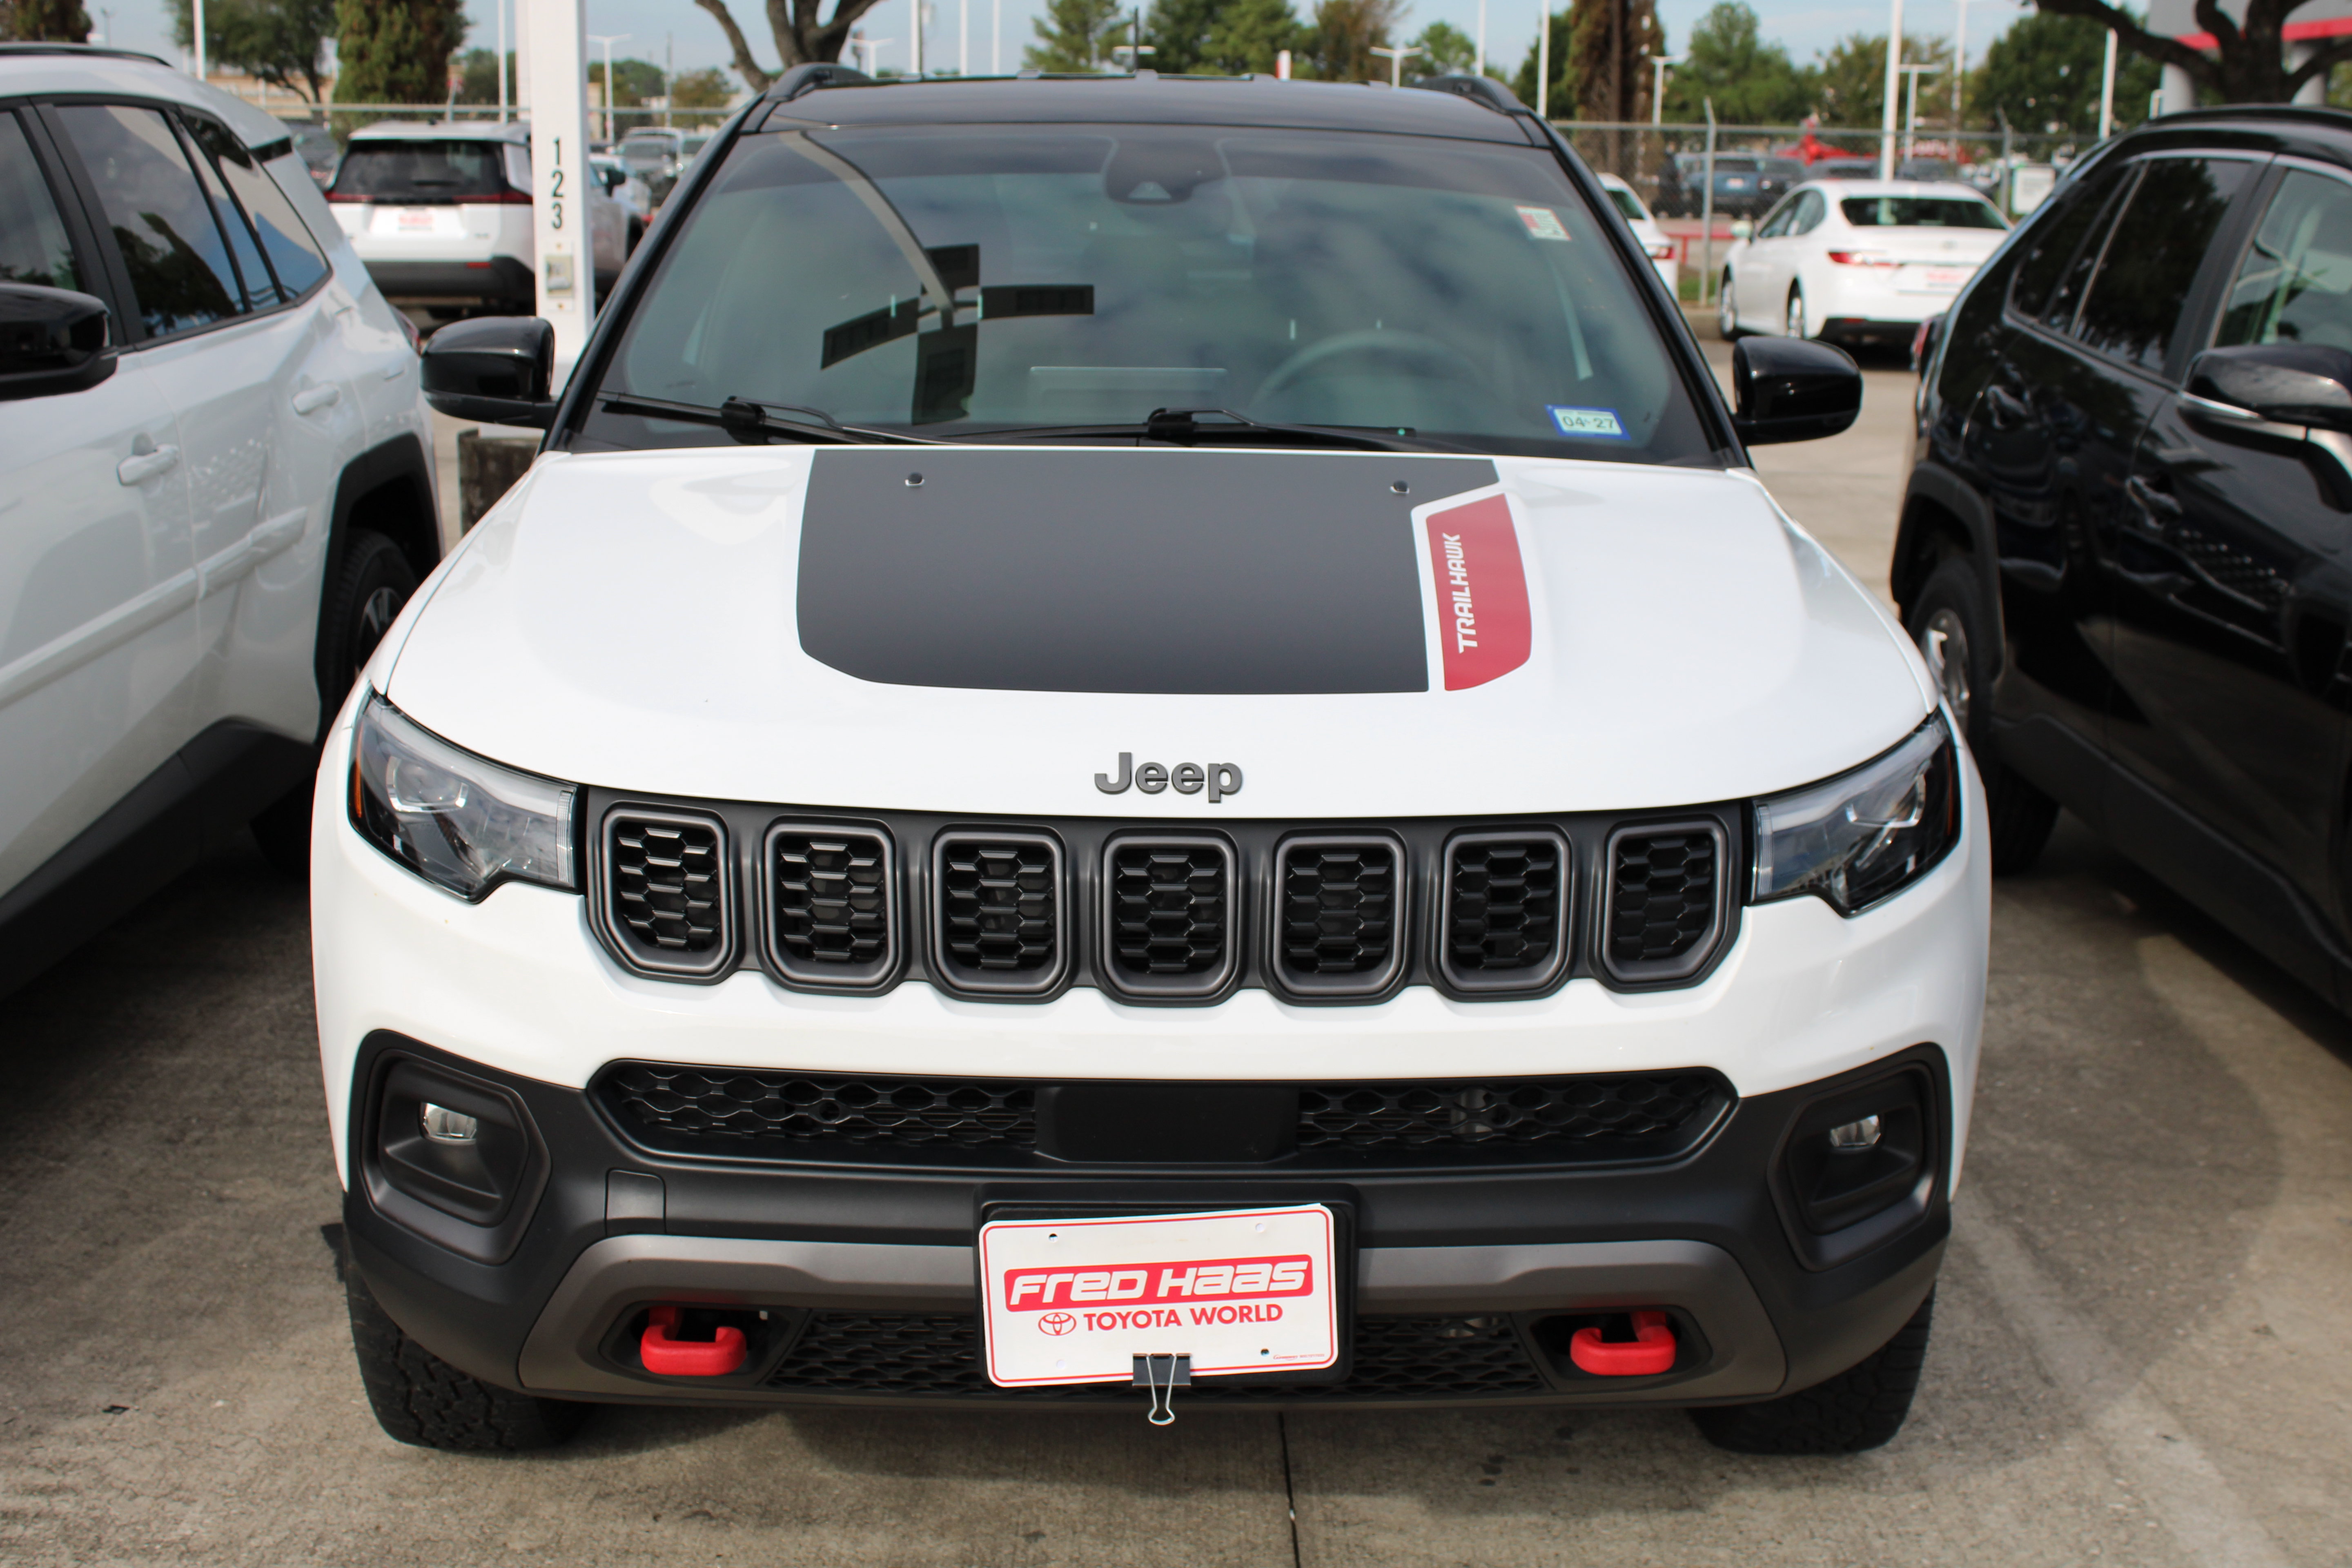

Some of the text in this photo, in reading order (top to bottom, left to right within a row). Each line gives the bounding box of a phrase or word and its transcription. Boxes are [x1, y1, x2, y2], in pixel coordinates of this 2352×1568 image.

[551, 136, 564, 229] 123
[1442, 532, 1478, 653] TRAILHAWK
[1094, 752, 1243, 803] Jeep
[1083, 1304, 1283, 1331] TOYOTA WORLD
